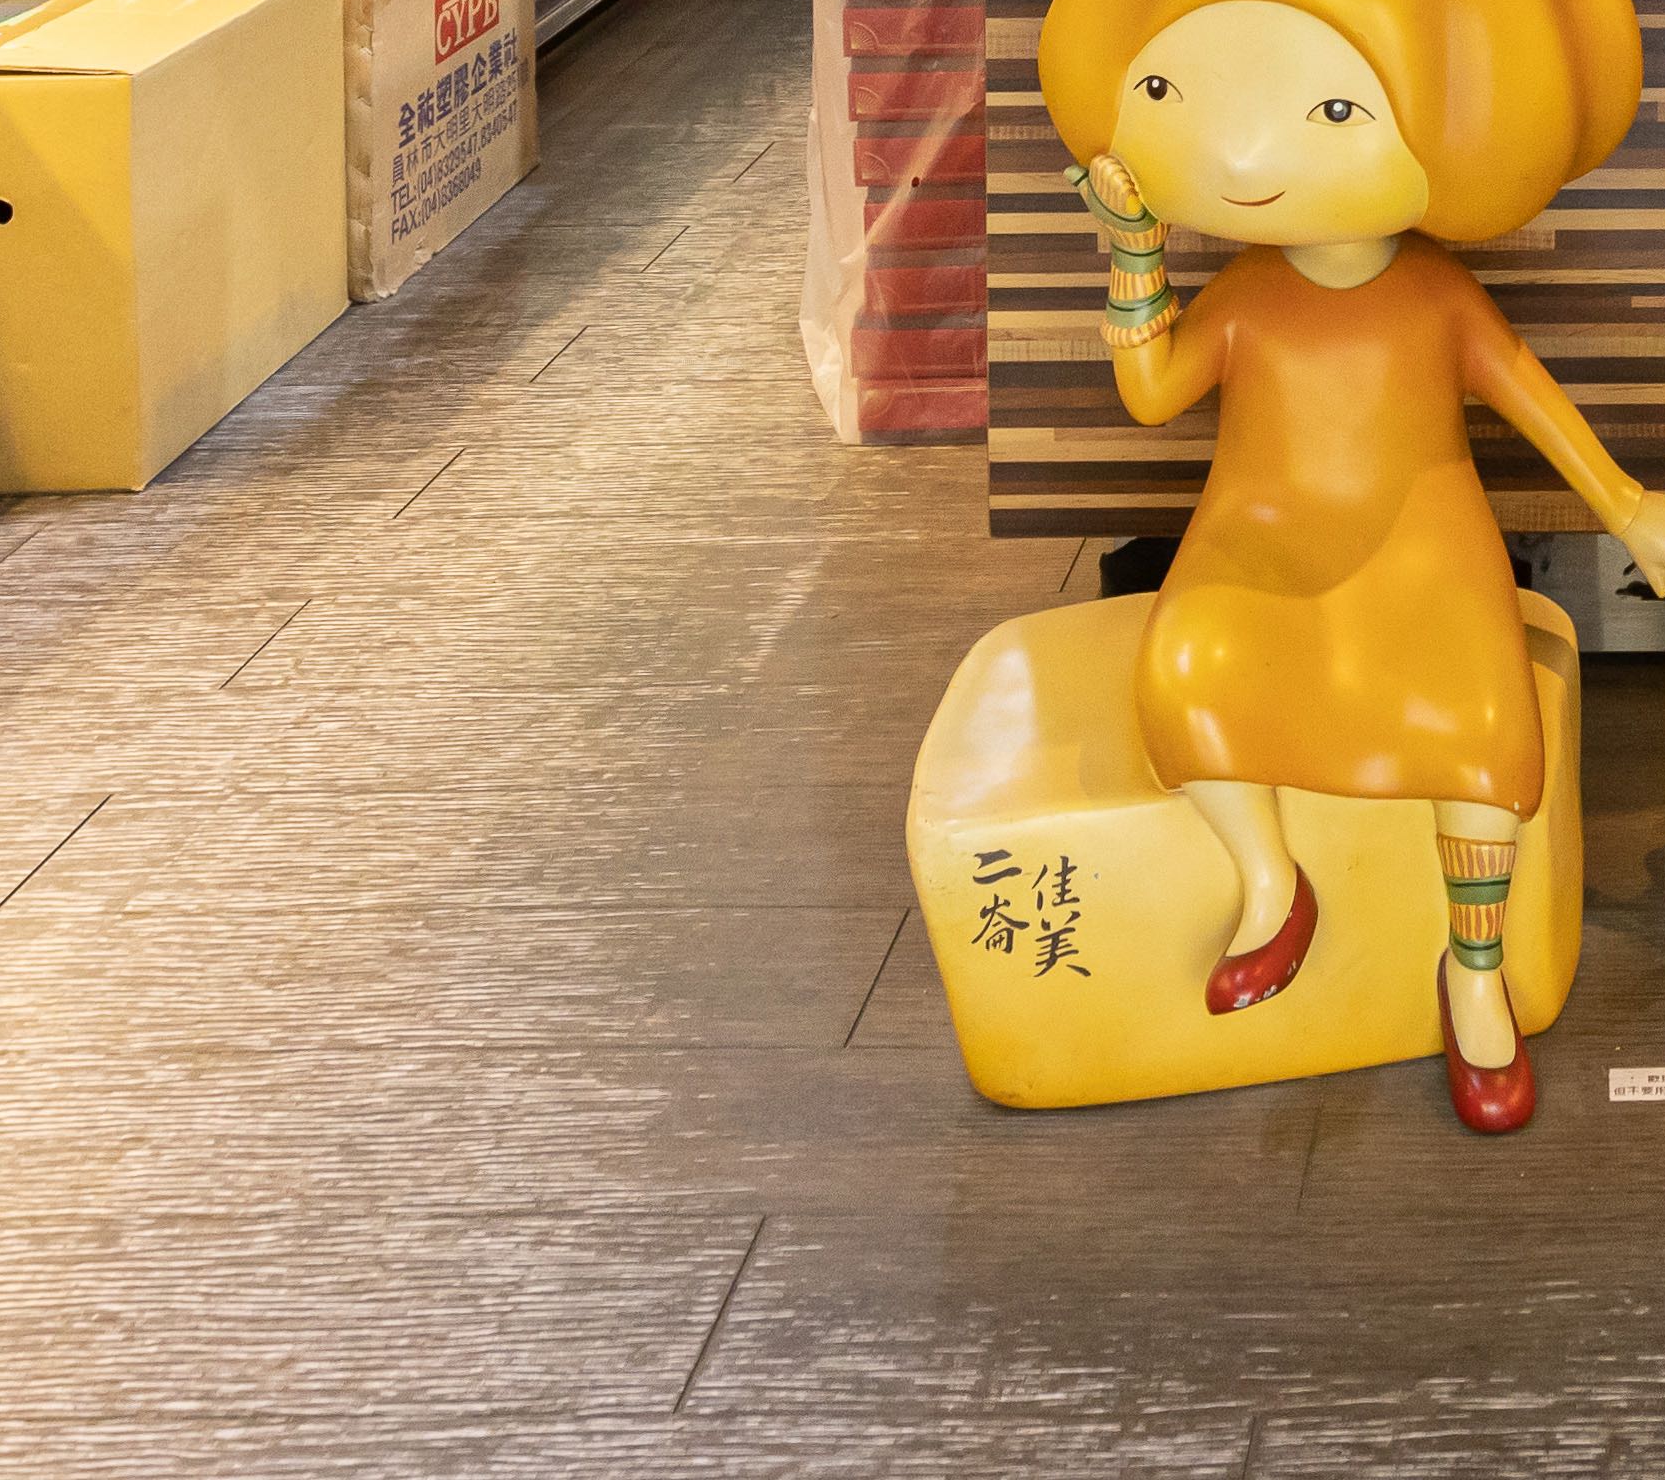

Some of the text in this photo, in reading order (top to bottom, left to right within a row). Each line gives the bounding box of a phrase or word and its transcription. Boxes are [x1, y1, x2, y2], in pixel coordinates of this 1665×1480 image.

[398, 28, 519, 149] 全祐塑膠企業社
